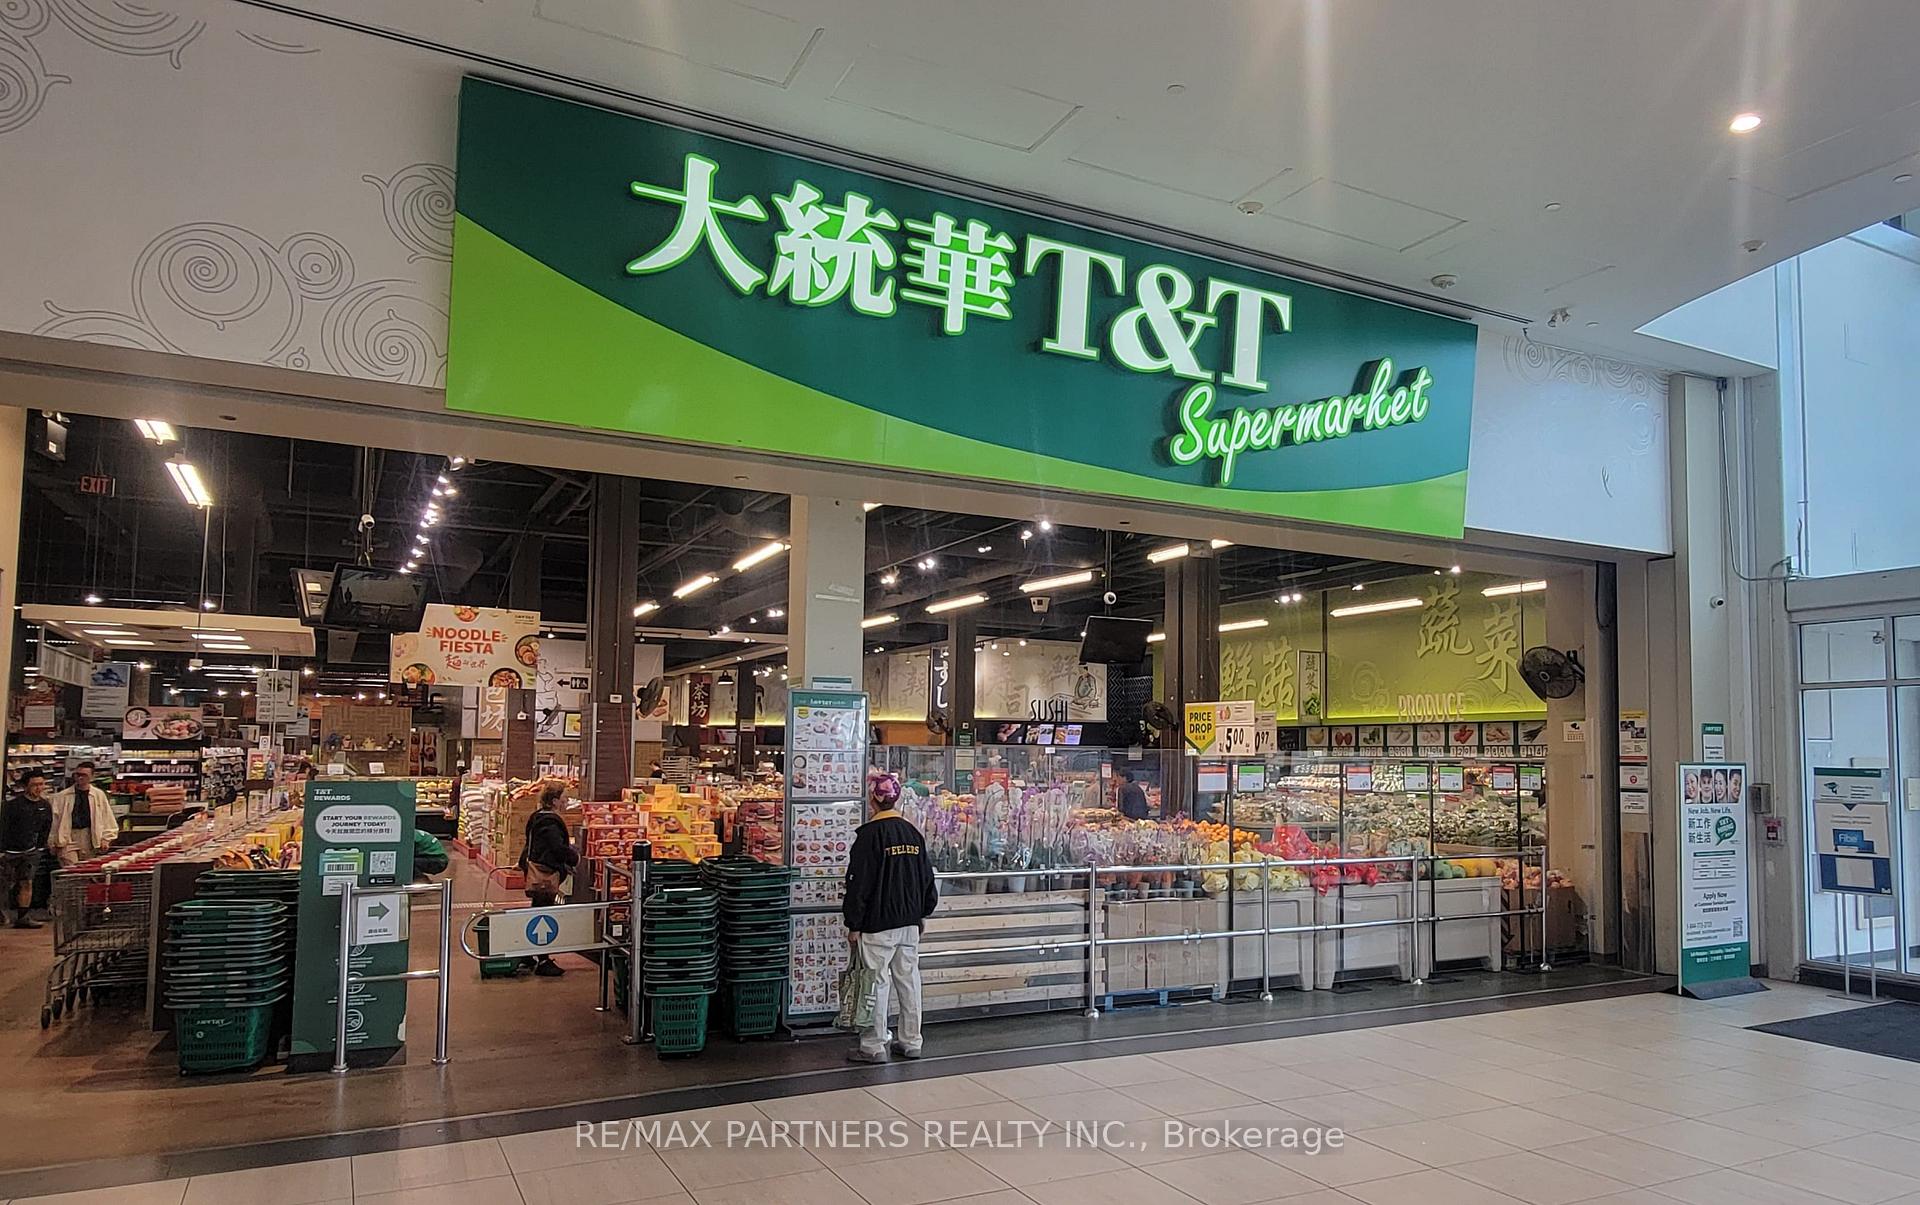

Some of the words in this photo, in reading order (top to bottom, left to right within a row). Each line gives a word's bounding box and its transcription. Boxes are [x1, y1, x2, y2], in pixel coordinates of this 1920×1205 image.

[626, 153, 1016, 335] 大統華
[1024, 234, 1292, 392] T&T
[1170, 357, 1433, 486] Supermarket
[80, 475, 108, 494] EXIT
[431, 626, 502, 642] NOODLE
[439, 640, 493, 655] FIESTA
[1029, 699, 1067, 721] SUSHI
[1189, 712, 1212, 722] PRICE
[1398, 692, 1466, 723] PRODUCE
[1189, 723, 1212, 735] DROP
